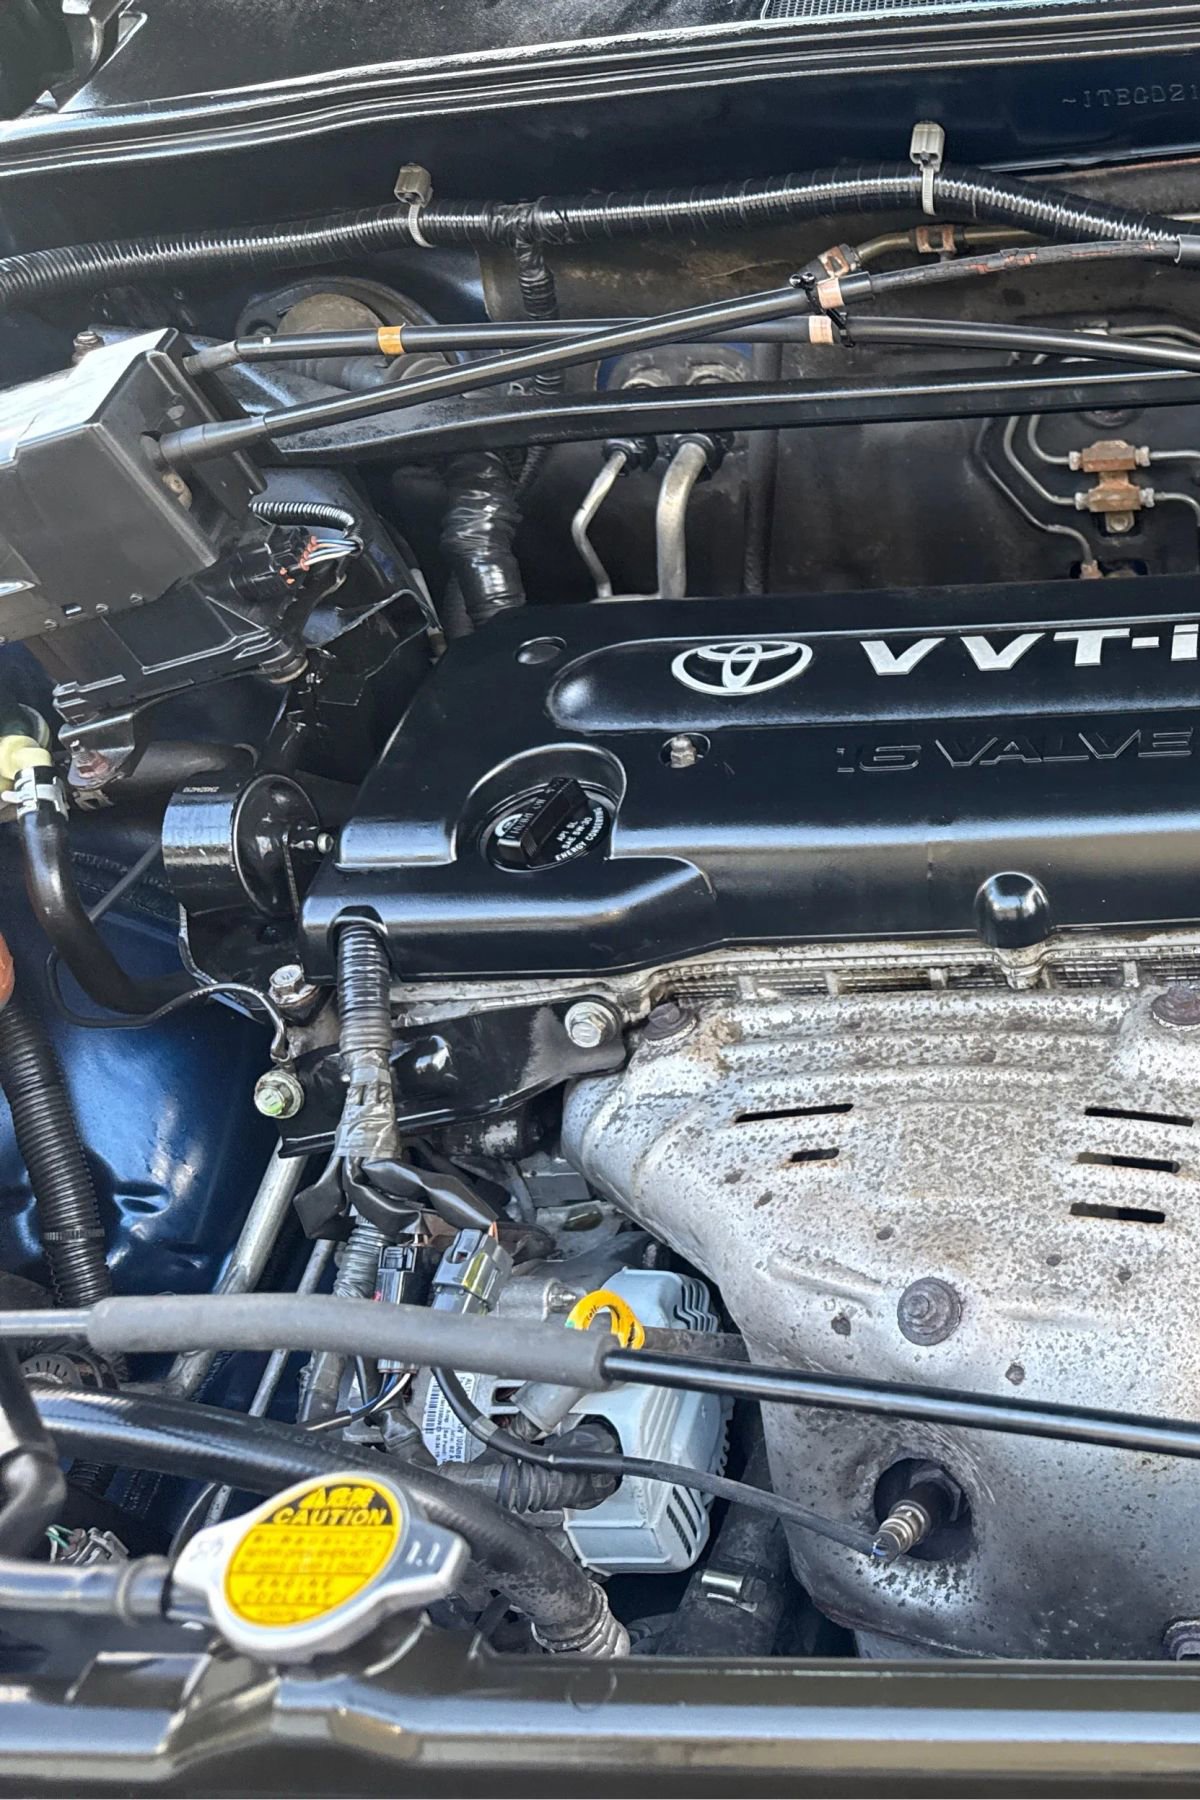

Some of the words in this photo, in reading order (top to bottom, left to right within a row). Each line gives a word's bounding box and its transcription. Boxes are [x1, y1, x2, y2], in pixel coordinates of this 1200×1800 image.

[860, 624, 1199, 676] VVT-i
[935, 727, 1194, 768] VALVE
[555, 840, 587, 861] ENERGY
[273, 1507, 387, 1525] CAUTION
[406, 1540, 440, 1567] 1.1
